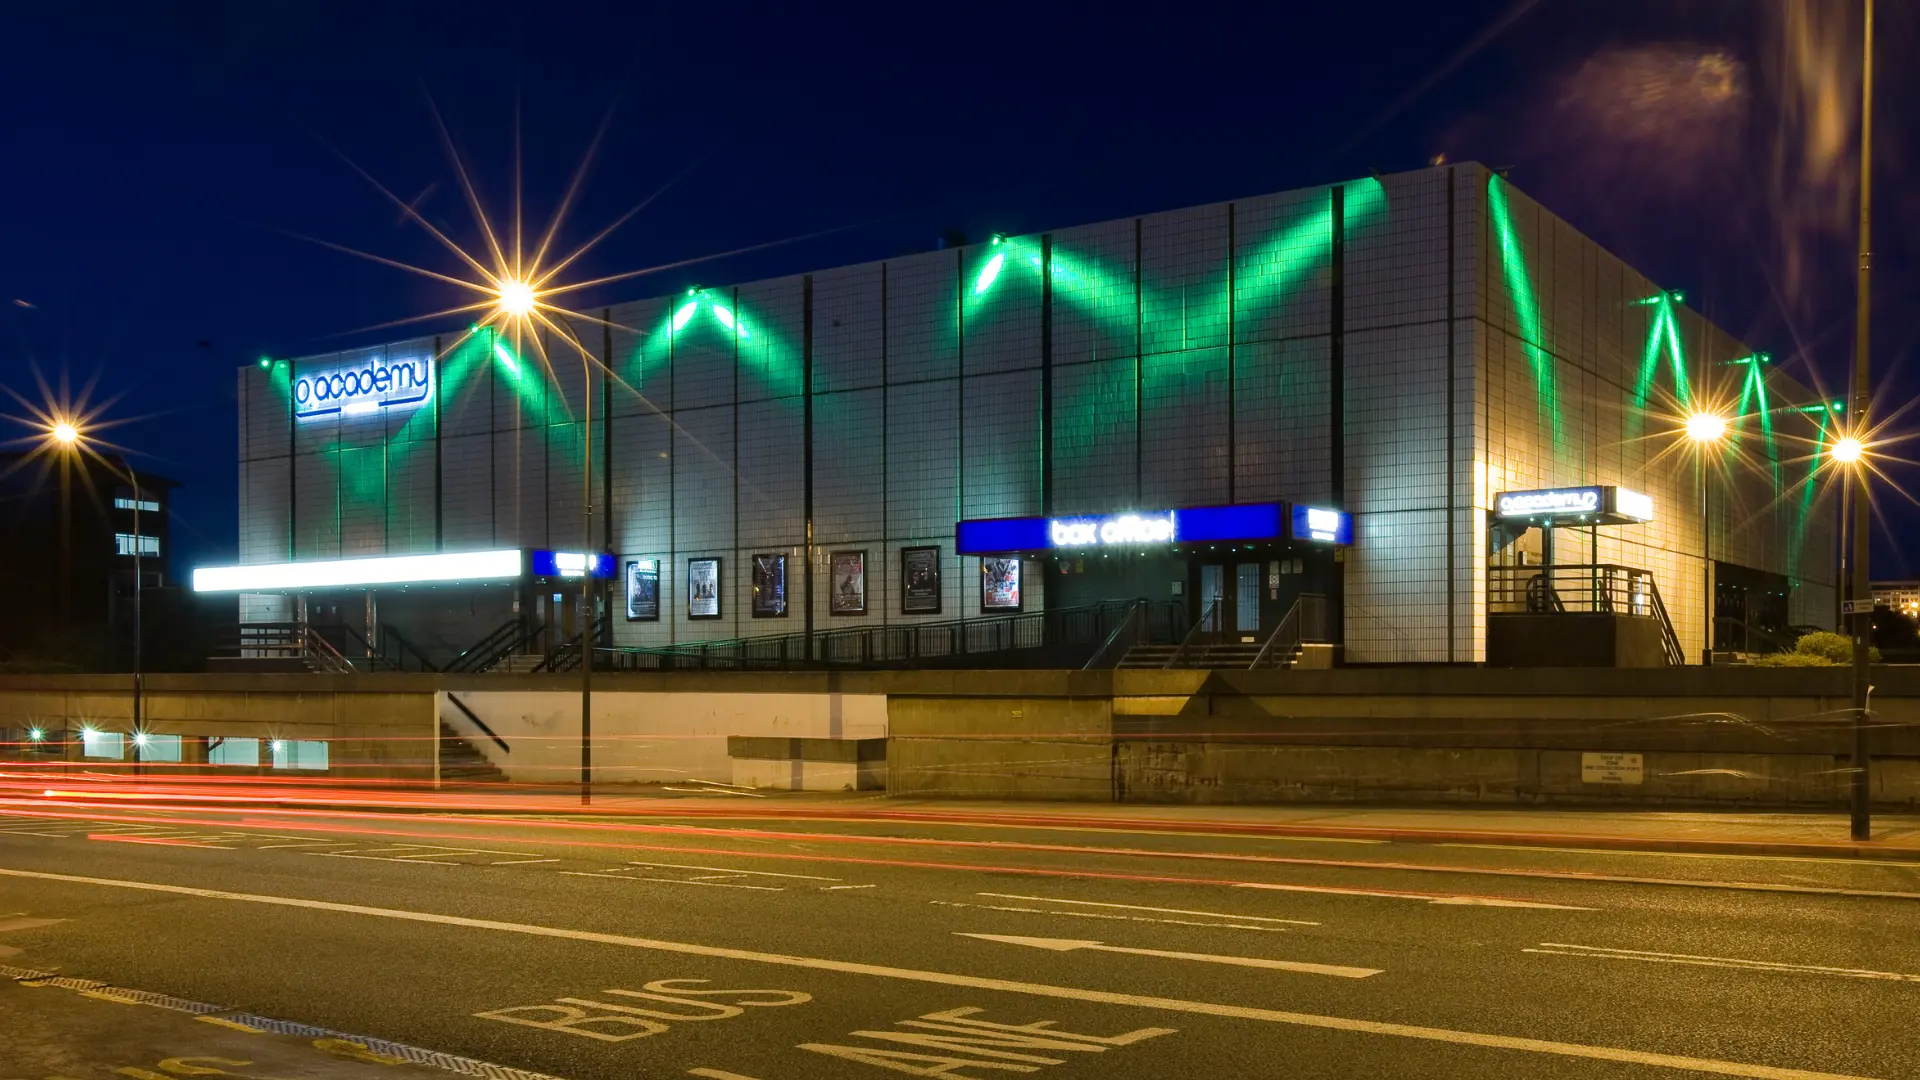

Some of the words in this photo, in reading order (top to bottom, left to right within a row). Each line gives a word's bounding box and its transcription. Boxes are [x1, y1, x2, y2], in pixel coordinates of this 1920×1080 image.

[314, 359, 429, 402] academy
[1052, 520, 1097, 545] box
[472, 979, 813, 1042] BUS
